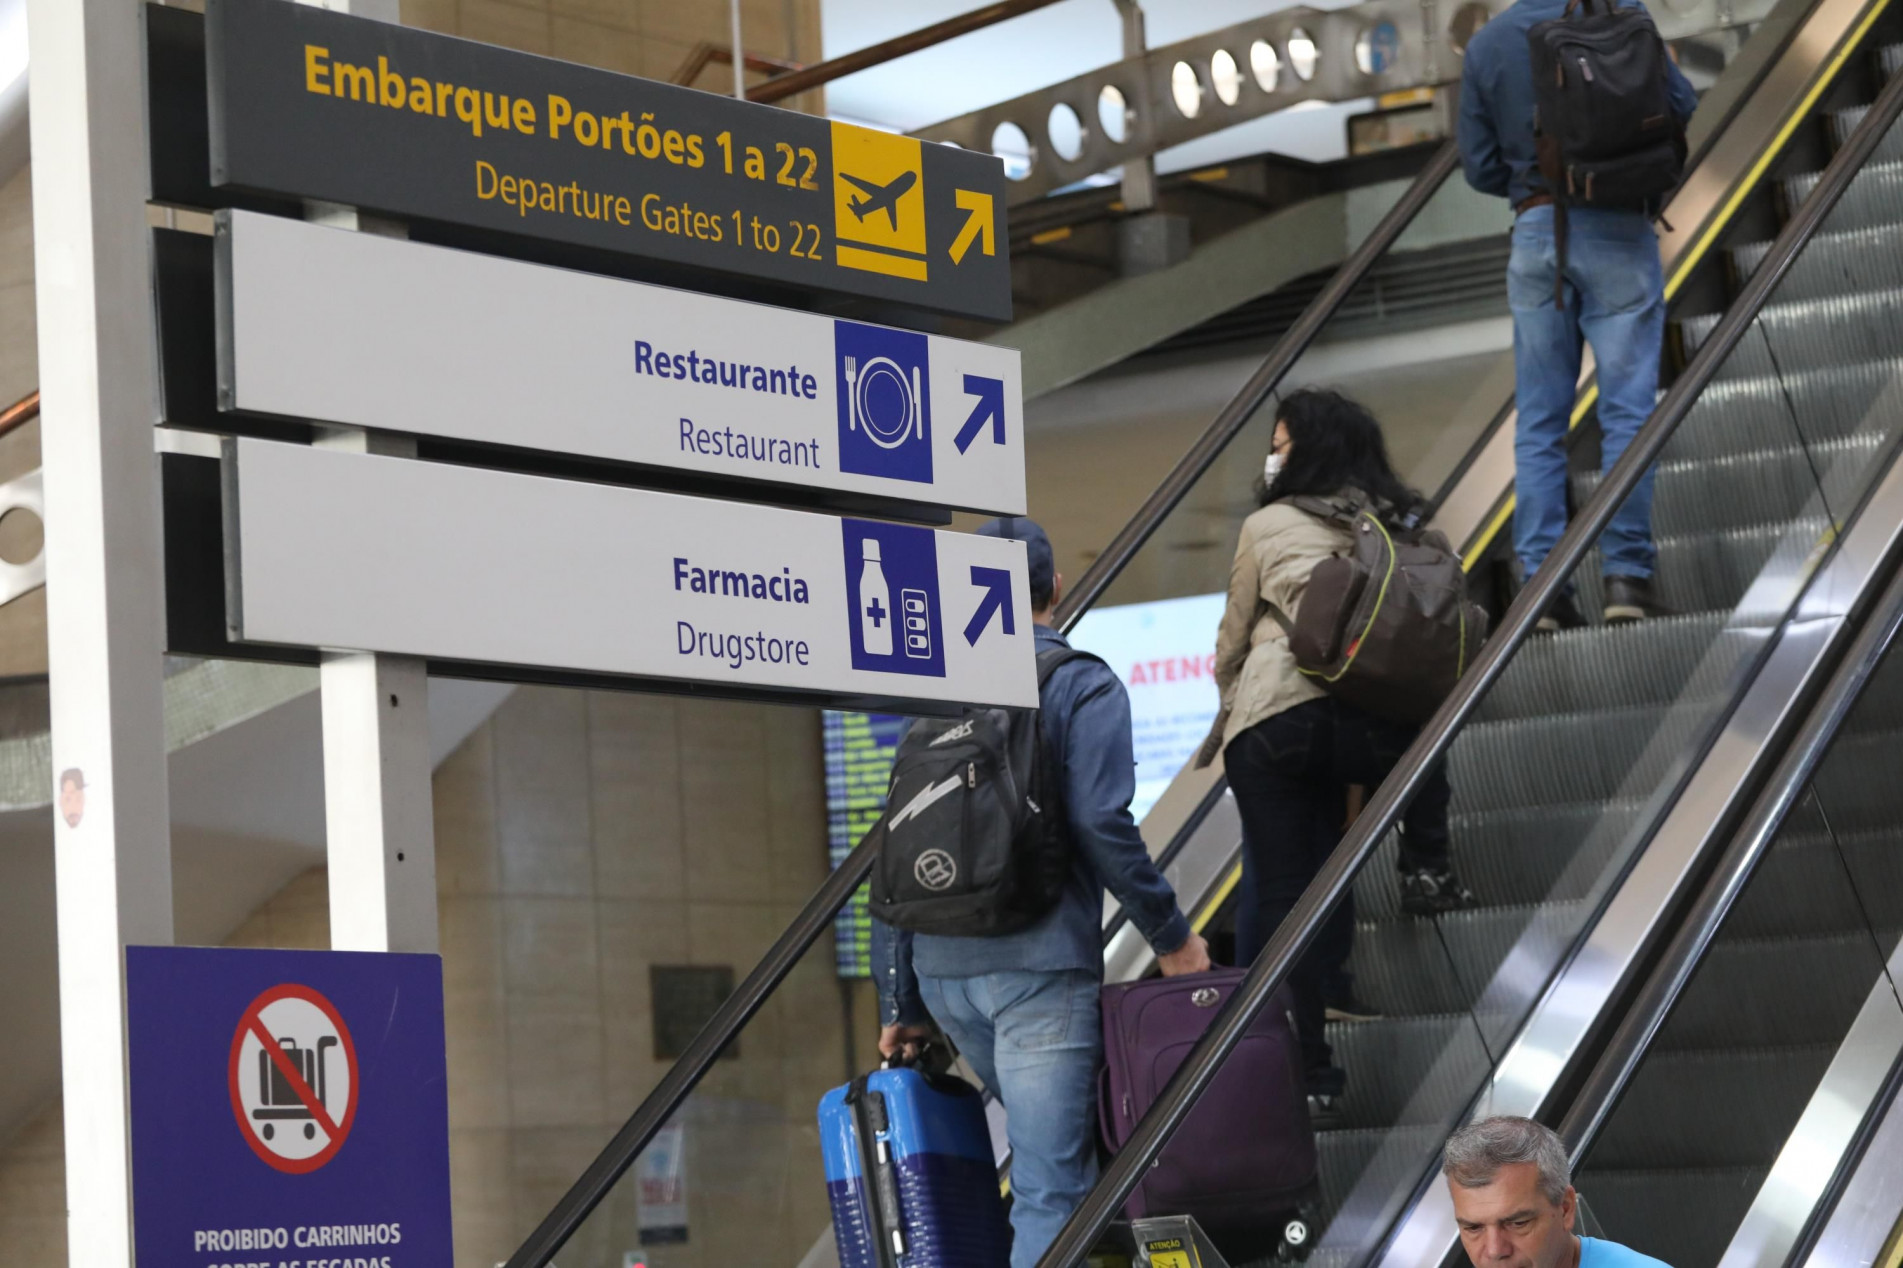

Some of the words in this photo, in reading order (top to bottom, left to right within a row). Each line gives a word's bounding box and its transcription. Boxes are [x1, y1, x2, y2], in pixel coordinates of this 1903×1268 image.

[304, 44, 537, 138] Embarque
[547, 93, 706, 169] Portões
[715, 131, 734, 175] 1
[743, 145, 766, 181] a
[775, 142, 820, 192] 22
[475, 159, 632, 226] Departure
[640, 193, 724, 243] Gates
[731, 209, 743, 246] 1
[750, 215, 781, 253] to
[789, 220, 823, 261] 22
[634, 340, 818, 400] Restaurante
[679, 417, 821, 469] Restaurant
[673, 557, 810, 604] Farmacia
[677, 620, 810, 669] Drugstore
[194, 1228, 289, 1251] PROIBIDO
[293, 1223, 401, 1247] CARRINHOS
[1149, 1240, 1181, 1250] ATENÇÃO
